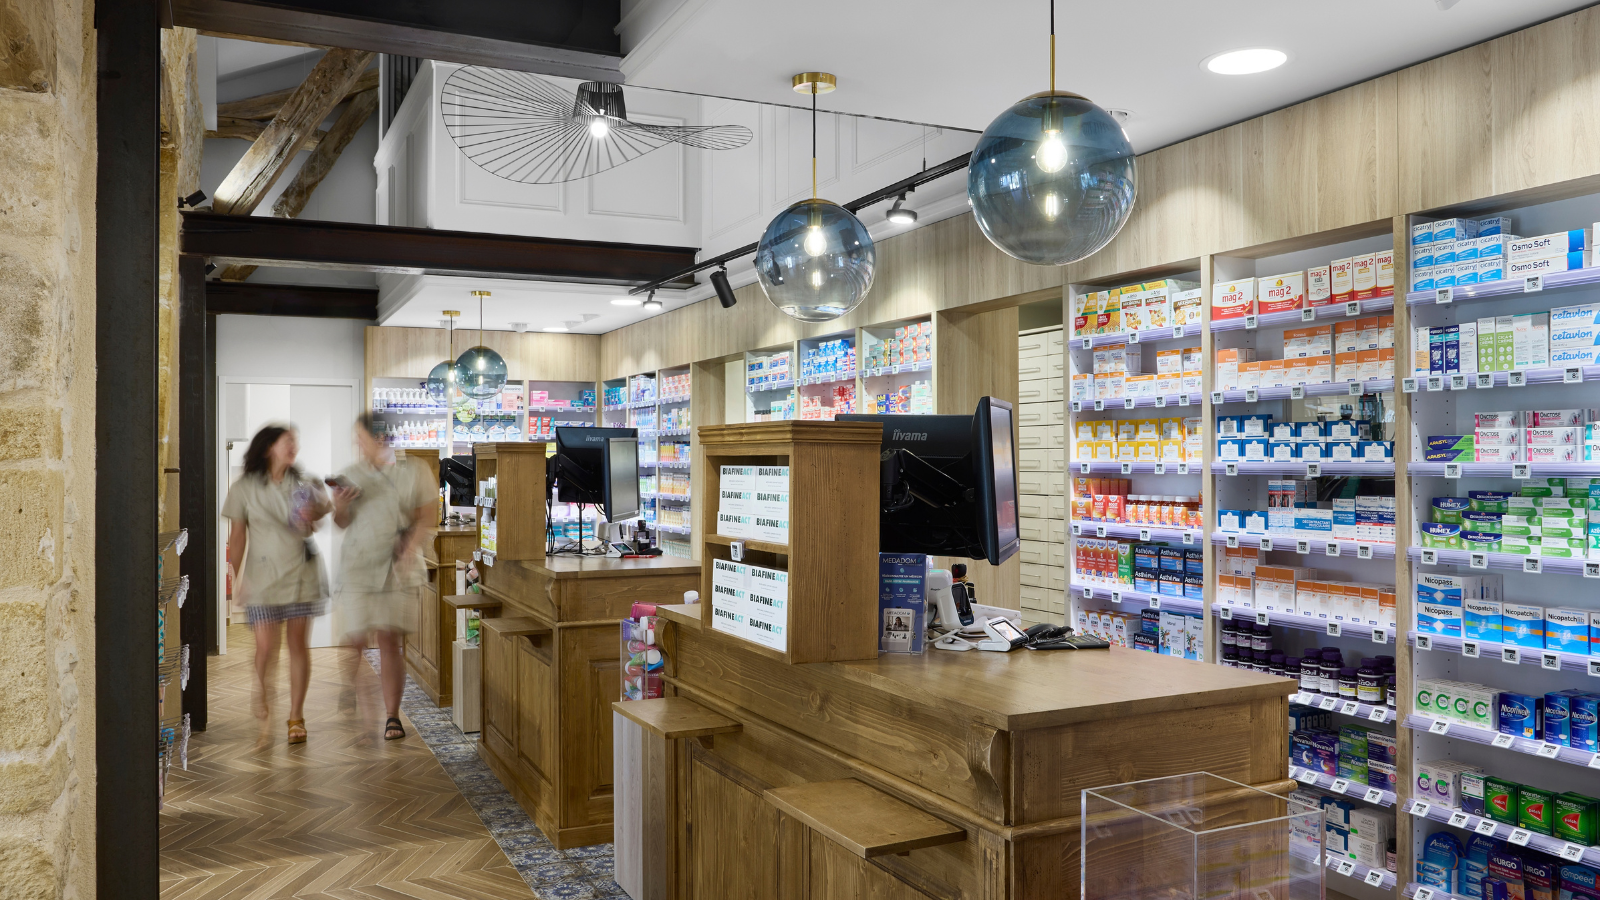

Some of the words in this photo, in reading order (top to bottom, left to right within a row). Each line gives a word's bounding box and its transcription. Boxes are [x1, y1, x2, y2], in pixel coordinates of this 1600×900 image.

[1435, 219, 1454, 228] cicatryl
[1457, 239, 1477, 247] cicatryl
[1480, 234, 1500, 243] cicatryl
[1511, 243, 1533, 252] Osmo
[1533, 239, 1551, 247] Soft
[1354, 260, 1368, 268] mag
[1377, 256, 1391, 264] mag
[1333, 264, 1346, 272] mag
[1435, 267, 1455, 275] cicatryl
[1457, 264, 1477, 272] cicatryl
[1511, 264, 1532, 272] Osmo
[1533, 260, 1550, 269] Soft
[1222, 293, 1237, 303] mag
[1238, 291, 1243, 300] 2
[1268, 288, 1285, 298] mag
[1286, 286, 1291, 295] 2
[1552, 308, 1593, 320] cetavlon
[1552, 330, 1593, 341] cetavlon
[1552, 351, 1593, 361] cetavlon
[892, 429, 928, 441] iiyama
[722, 467, 753, 476] BIAFINEACT
[758, 467, 789, 477] BIAFINEAC
[721, 490, 751, 500] BIAFINEACT
[756, 492, 789, 503] BIAFINEAC
[720, 513, 751, 525] BIAFINEACT
[715, 561, 746, 575] BIAFINEACT
[751, 568, 787, 583] BIAFINEACT
[1424, 577, 1453, 586] Nicopass
[714, 584, 745, 599] BIAFINEACT
[749, 593, 784, 609] BIAFINEACT
[1424, 606, 1453, 616] Nicopass
[1467, 604, 1499, 612] Nicopatchlib
[1505, 608, 1540, 618] Nicopatchlib
[714, 607, 744, 623] BIAFINEACT
[1548, 613, 1585, 623] Nicopatchlib
[749, 617, 783, 635] BIAFINEACT
[1172, 647, 1182, 656] bio
[1292, 794, 1314, 804] Spasmine
[1430, 839, 1450, 850] Activir
[1497, 857, 1517, 869] URGO
[1524, 864, 1546, 877] URGO
[1561, 868, 1594, 885] Compeed
